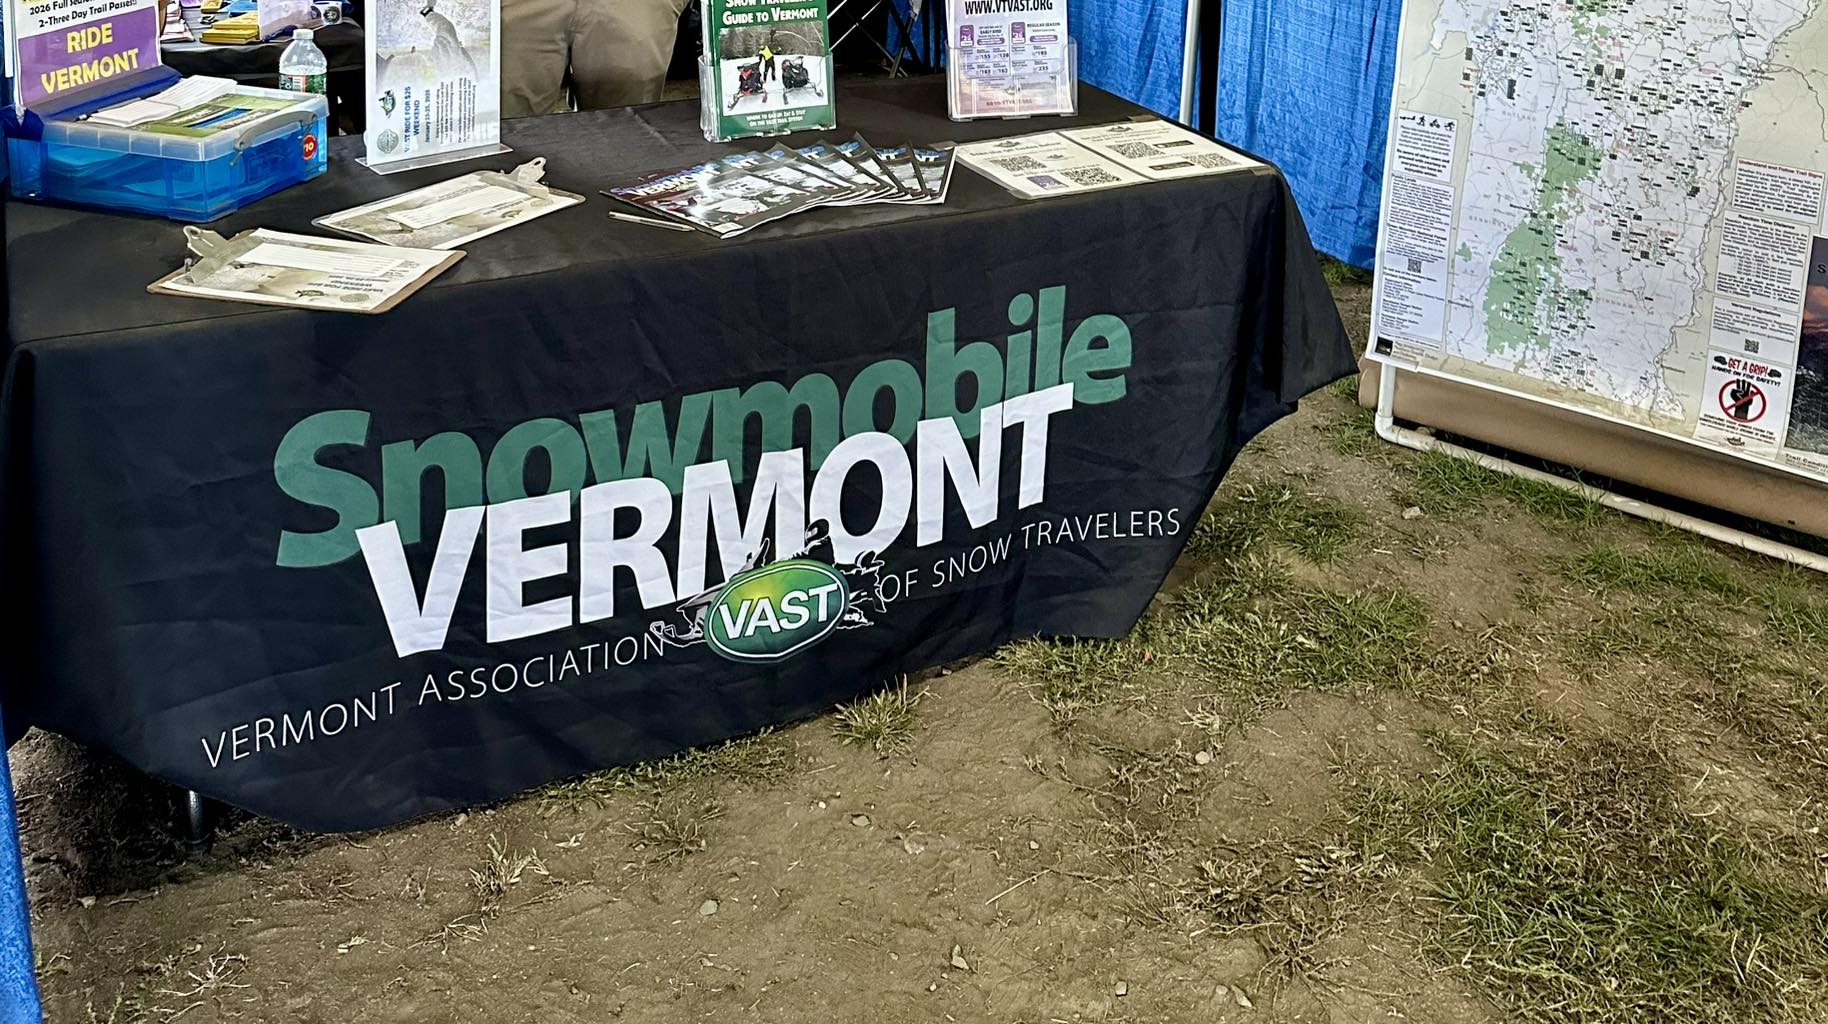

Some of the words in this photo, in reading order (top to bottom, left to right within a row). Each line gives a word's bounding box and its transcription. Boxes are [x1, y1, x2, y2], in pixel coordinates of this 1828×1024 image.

[29, 2, 51, 16] 2026
[52, 0, 68, 13] Full
[38, 13, 69, 29] 2-Three
[71, 9, 87, 25] Day
[88, 4, 107, 19] Trail
[722, 10, 754, 26] GUIDE
[755, 11, 769, 22] TO
[770, 7, 819, 21] VERMONT
[66, 22, 113, 54] RIDE
[41, 48, 140, 94] VERMONT
[1727, 357, 1741, 370] GET
[1742, 361, 1748, 372] A
[1749, 362, 1769, 377] GRIP!
[273, 284, 1133, 569] Snowmobile
[355, 382, 1074, 658] VERMONT
[718, 583, 840, 640] VAST
[201, 683, 401, 770] VERMONT
[419, 631, 665, 707] ASSOCIATION
[881, 575, 918, 602] OF
[933, 539, 1013, 588] SNOW
[1020, 507, 1181, 551] TRAVELERS
